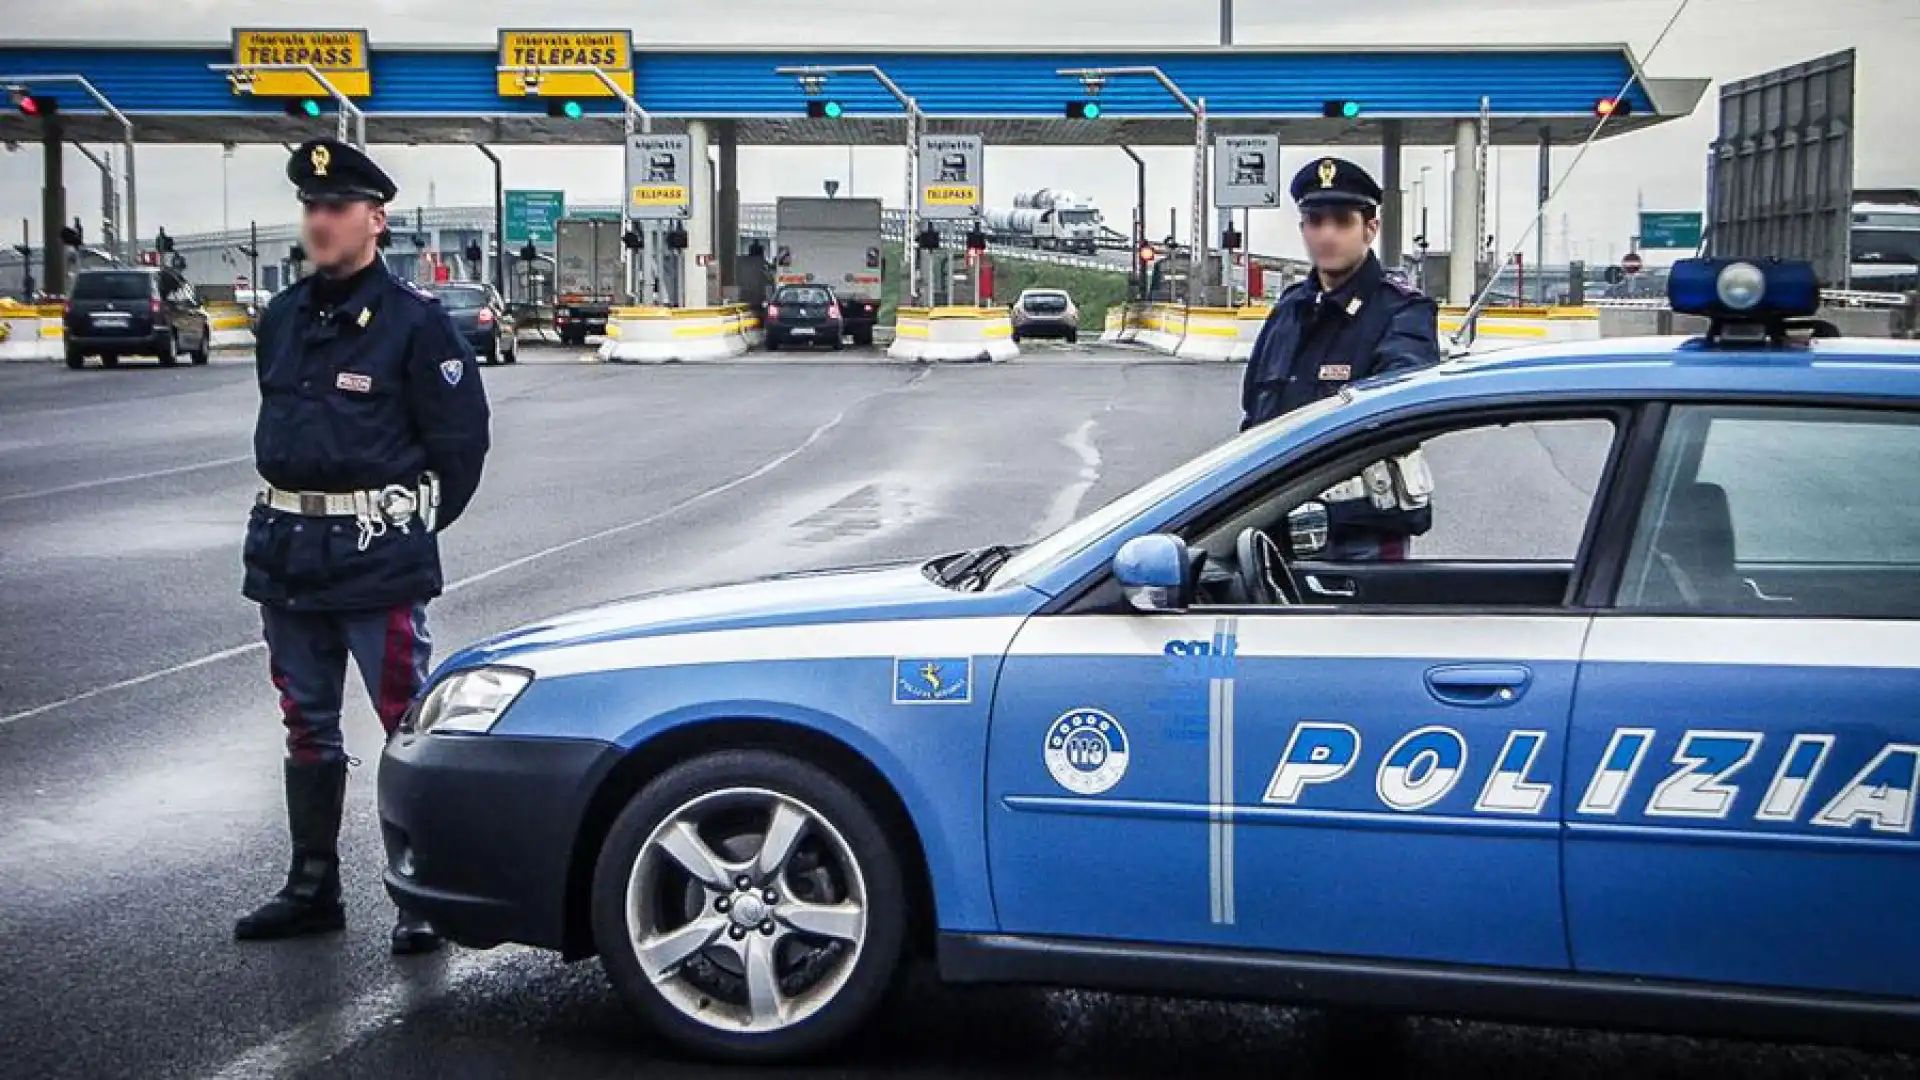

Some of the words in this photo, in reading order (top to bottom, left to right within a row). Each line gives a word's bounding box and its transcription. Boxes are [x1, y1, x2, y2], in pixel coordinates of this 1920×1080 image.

[248, 46, 353, 65] TELEPASS
[514, 47, 617, 65] TELEPASS
[635, 188, 683, 200] TELEPASS
[927, 188, 974, 200] TELEPASS
[1070, 738, 1102, 764] 113
[1262, 720, 1920, 833] POLIZIA
